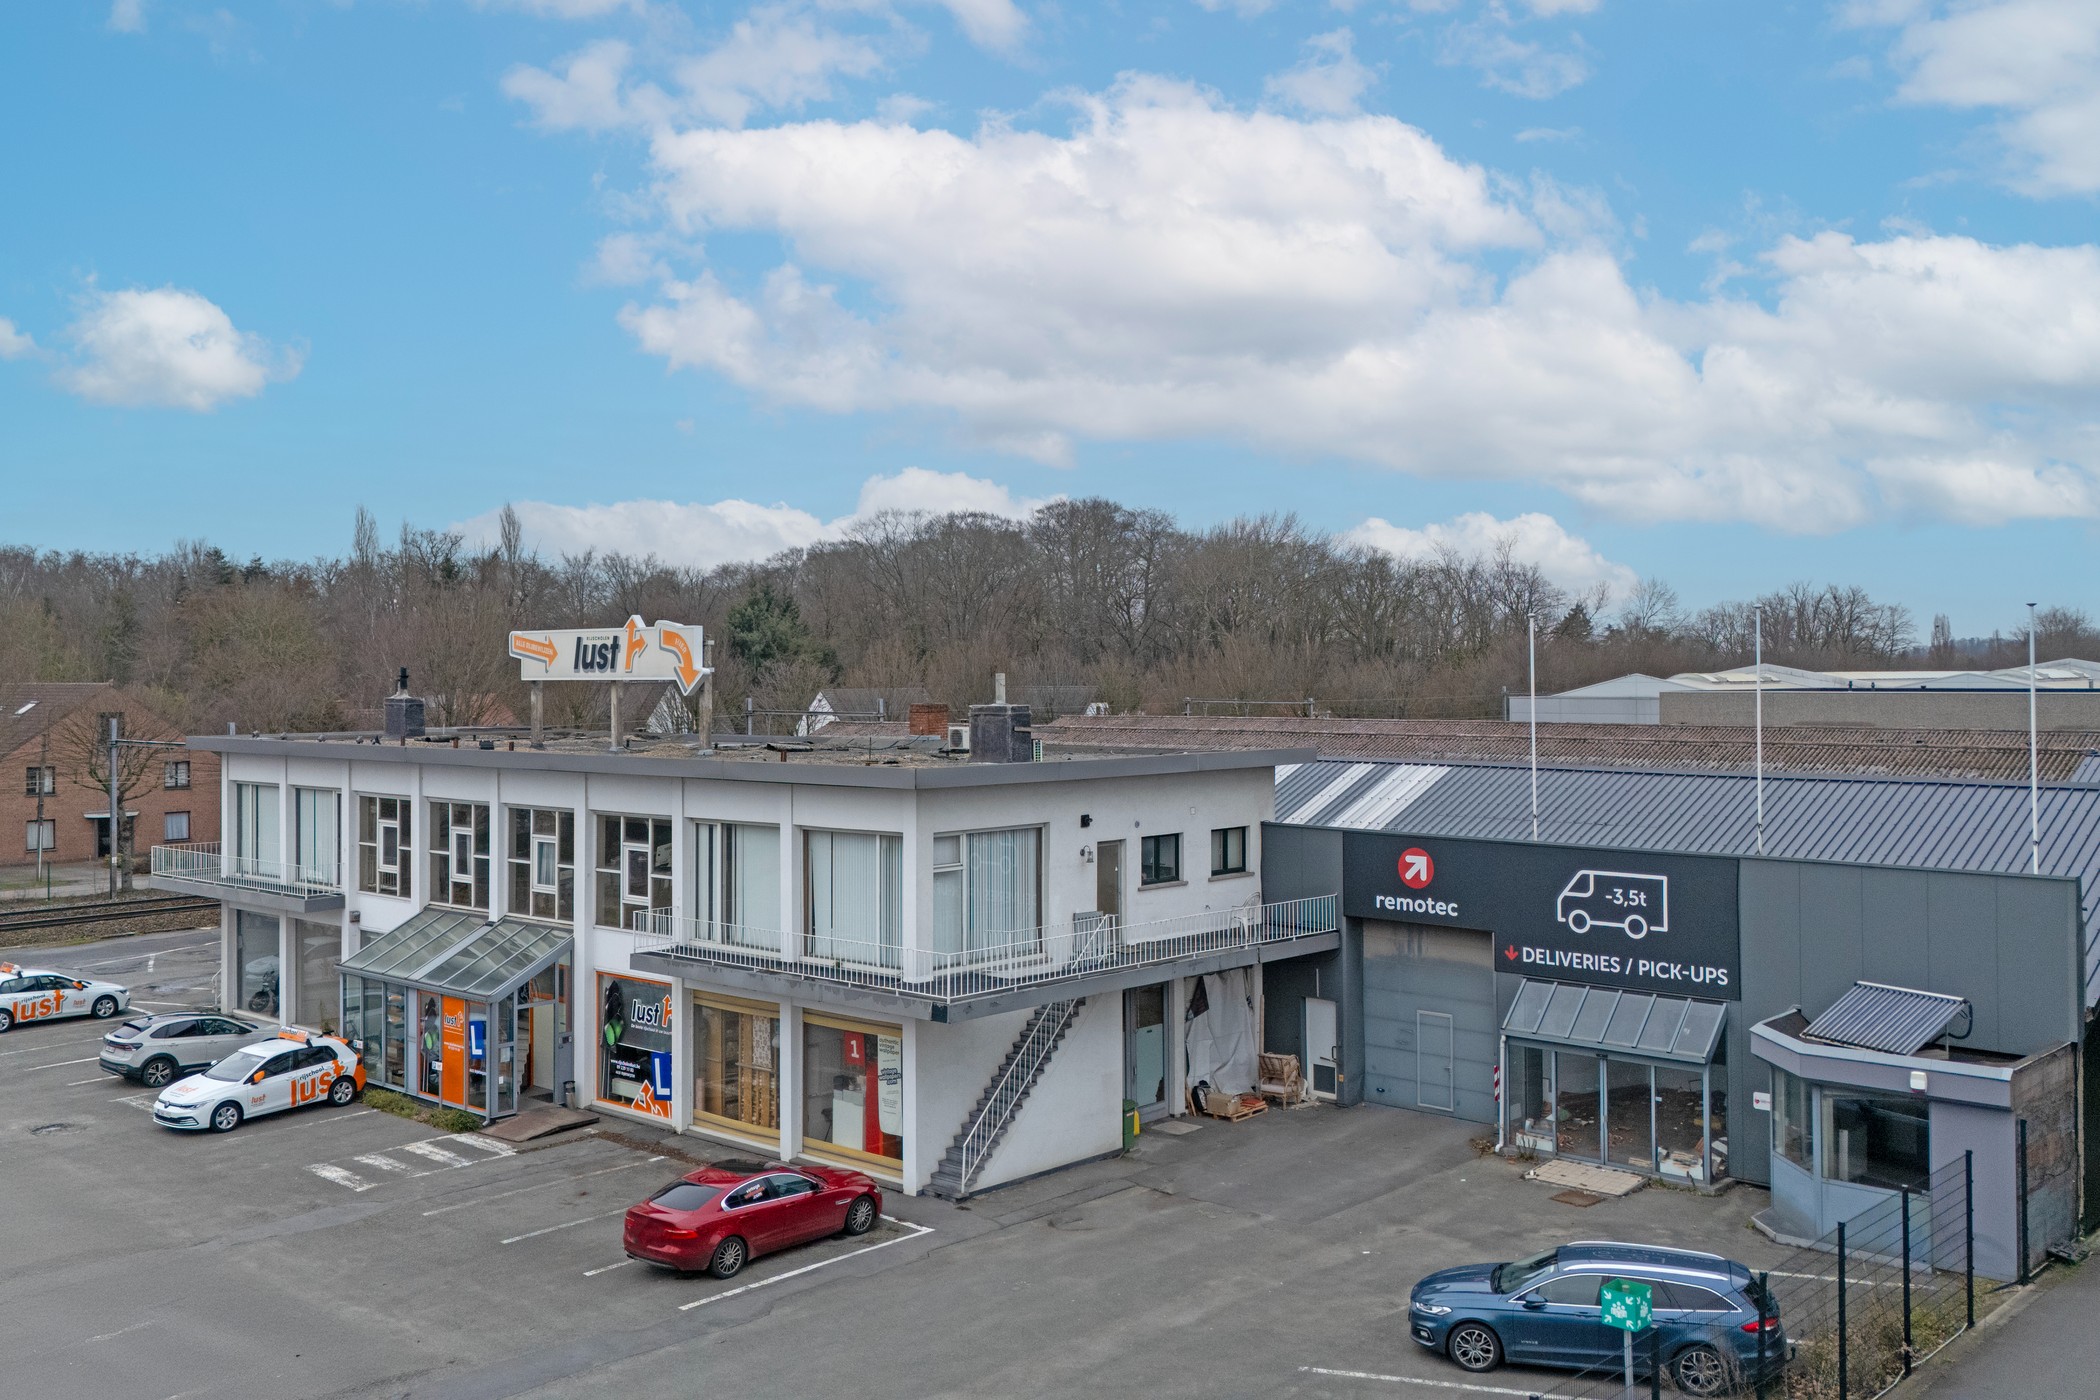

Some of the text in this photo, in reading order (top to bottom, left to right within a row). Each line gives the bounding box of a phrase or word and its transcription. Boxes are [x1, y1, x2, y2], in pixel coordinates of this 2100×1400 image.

[574, 635, 620, 672] lust
[674, 637, 687, 654] HIER
[1375, 895, 1459, 917] remotec
[1605, 888, 1647, 908] -3,5t
[1522, 946, 1729, 986] DELIVERIES / PICK-UPS
[12, 989, 66, 1024] lust
[631, 998, 661, 1027] lust
[470, 1025, 483, 1055] L
[850, 1040, 860, 1058] 1
[290, 1058, 346, 1108] lust
[299, 1066, 325, 1081] rijschool
[654, 1057, 670, 1096] L
